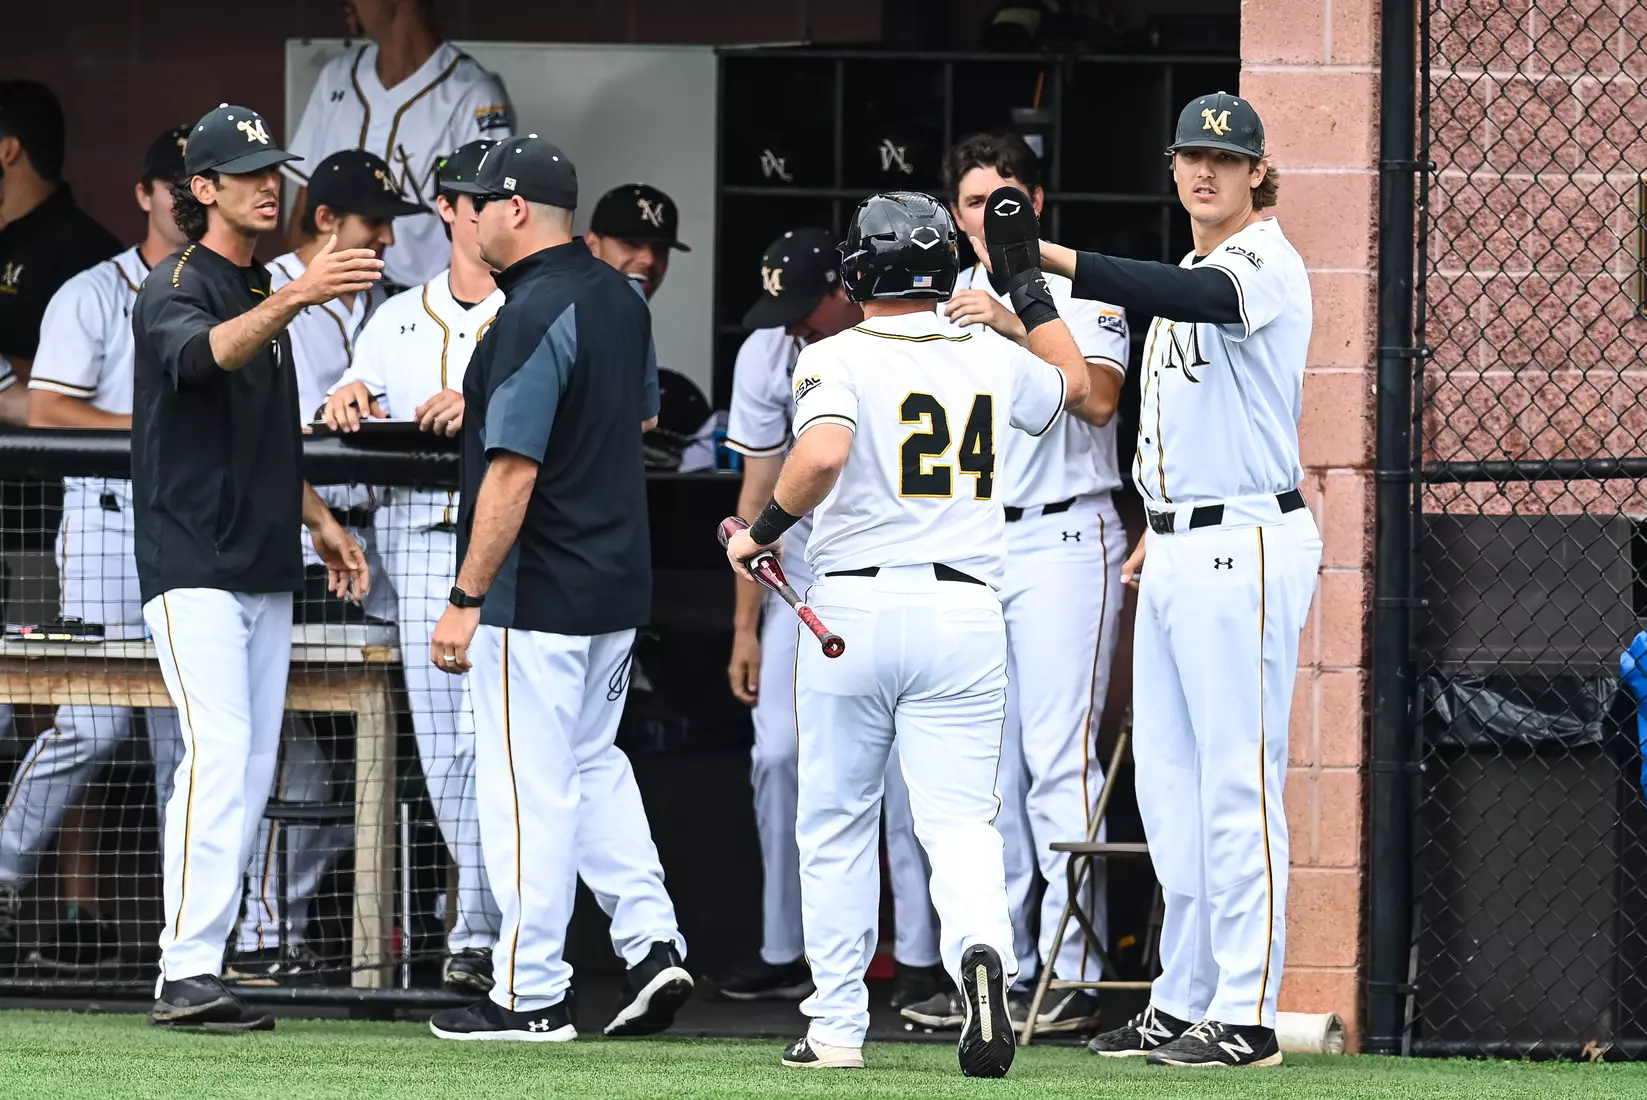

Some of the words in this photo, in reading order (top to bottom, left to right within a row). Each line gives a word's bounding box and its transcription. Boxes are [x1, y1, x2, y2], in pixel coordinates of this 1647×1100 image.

[237, 119, 270, 144] M
[1201, 108, 1232, 136] M
[637, 198, 664, 228] M
[761, 266, 784, 297] M
[898, 390, 996, 500] 24
[1218, 1033, 1254, 1063] N
